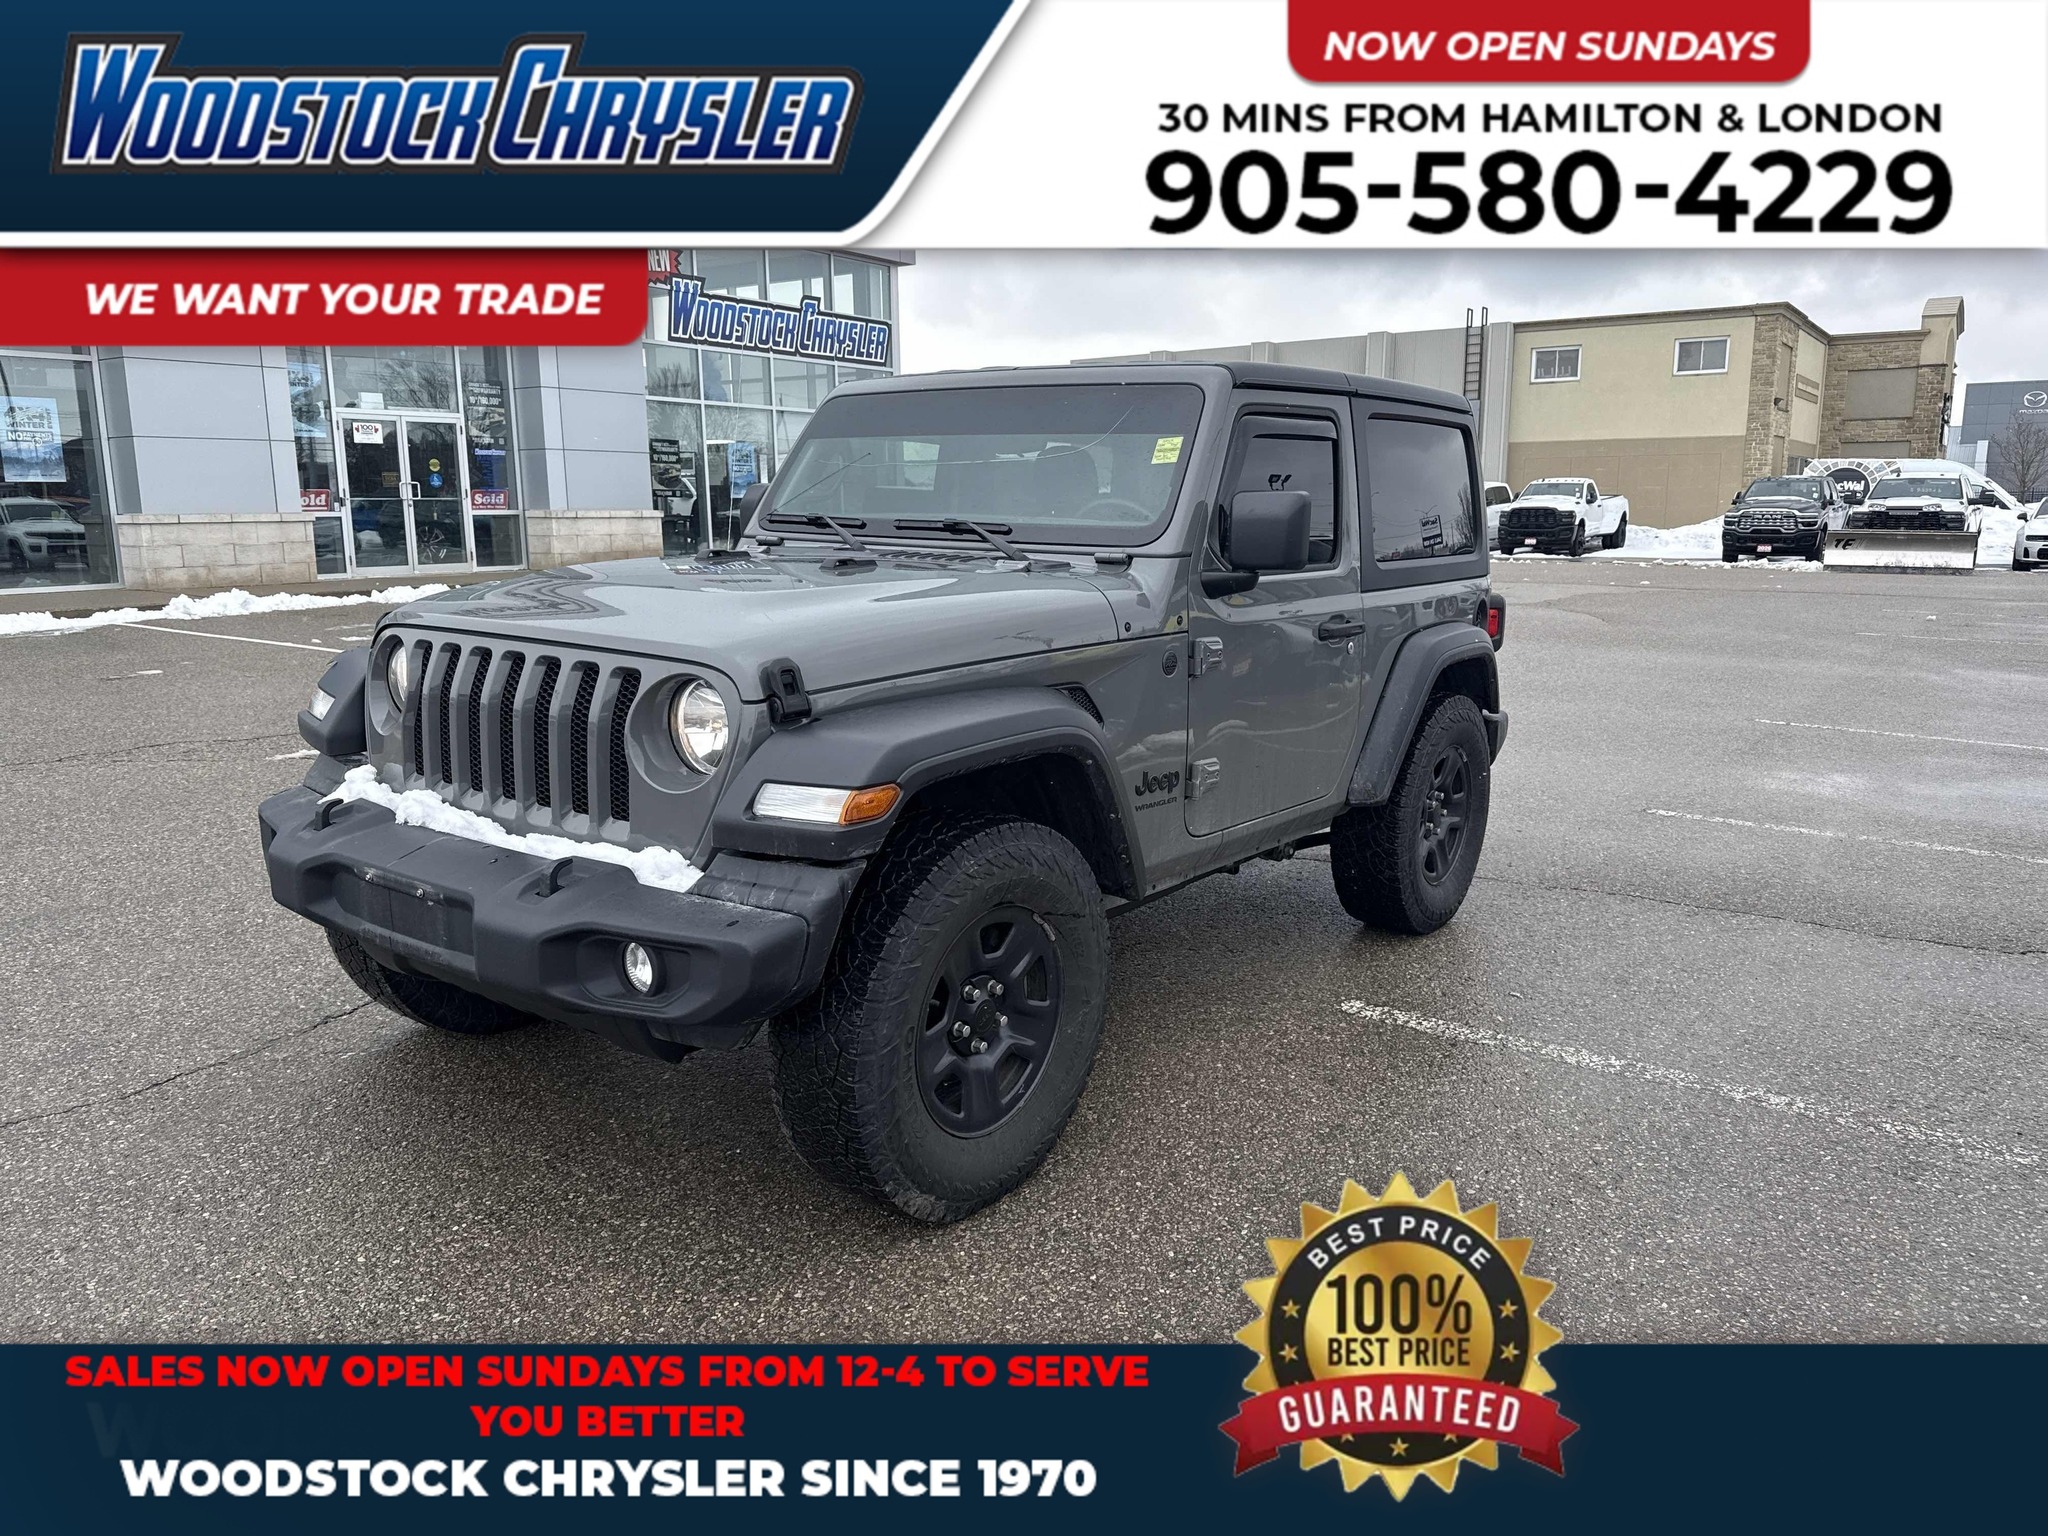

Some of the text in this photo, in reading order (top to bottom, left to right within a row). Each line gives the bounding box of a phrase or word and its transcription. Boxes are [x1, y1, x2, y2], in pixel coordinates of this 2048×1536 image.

[648, 250, 670, 272] NEW
[300, 493, 326, 506] old
[473, 493, 505, 505] Sold
[1135, 770, 1180, 796] Jeep
[1134, 796, 1178, 812] WRANGLER
